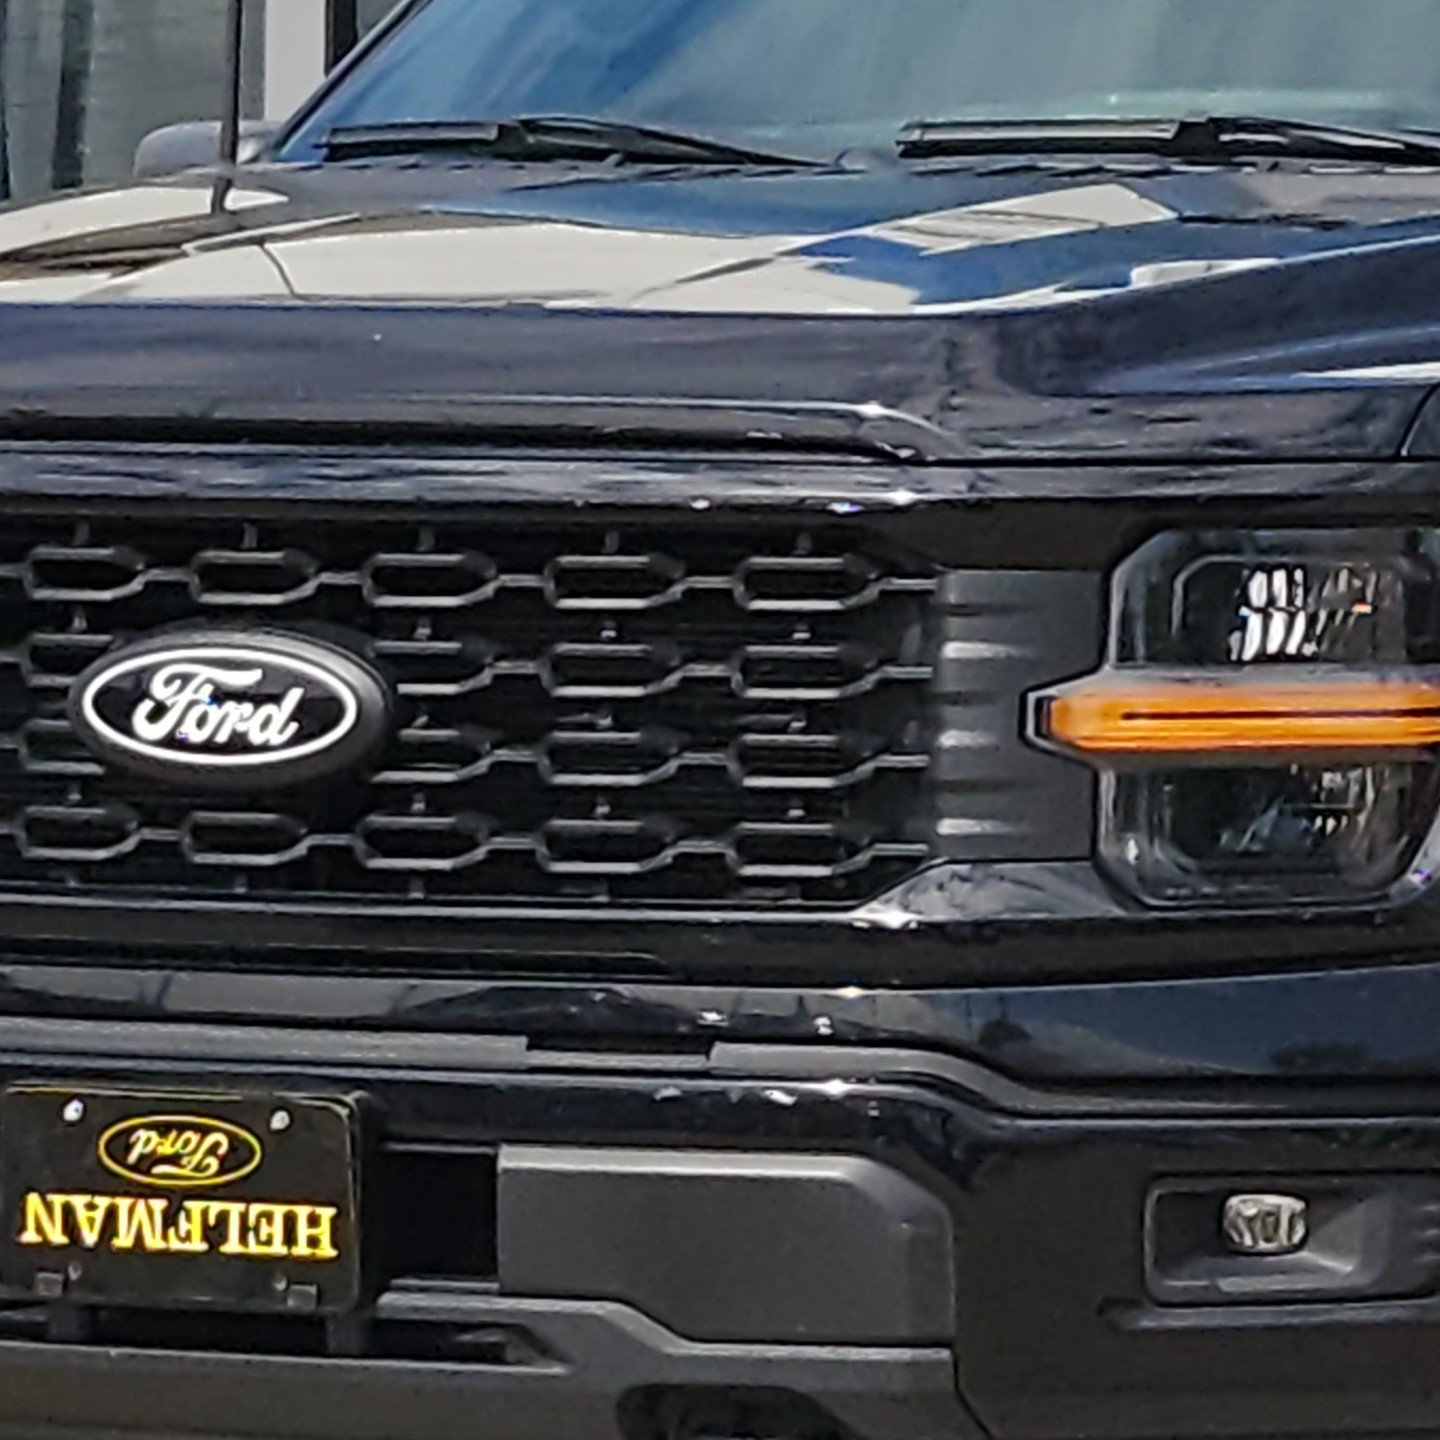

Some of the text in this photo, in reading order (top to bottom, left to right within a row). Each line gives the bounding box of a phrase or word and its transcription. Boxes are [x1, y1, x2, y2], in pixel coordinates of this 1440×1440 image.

[131, 662, 305, 747] Ford
[126, 1127, 230, 1177] Ford
[16, 1190, 340, 1260] HELFMAN
